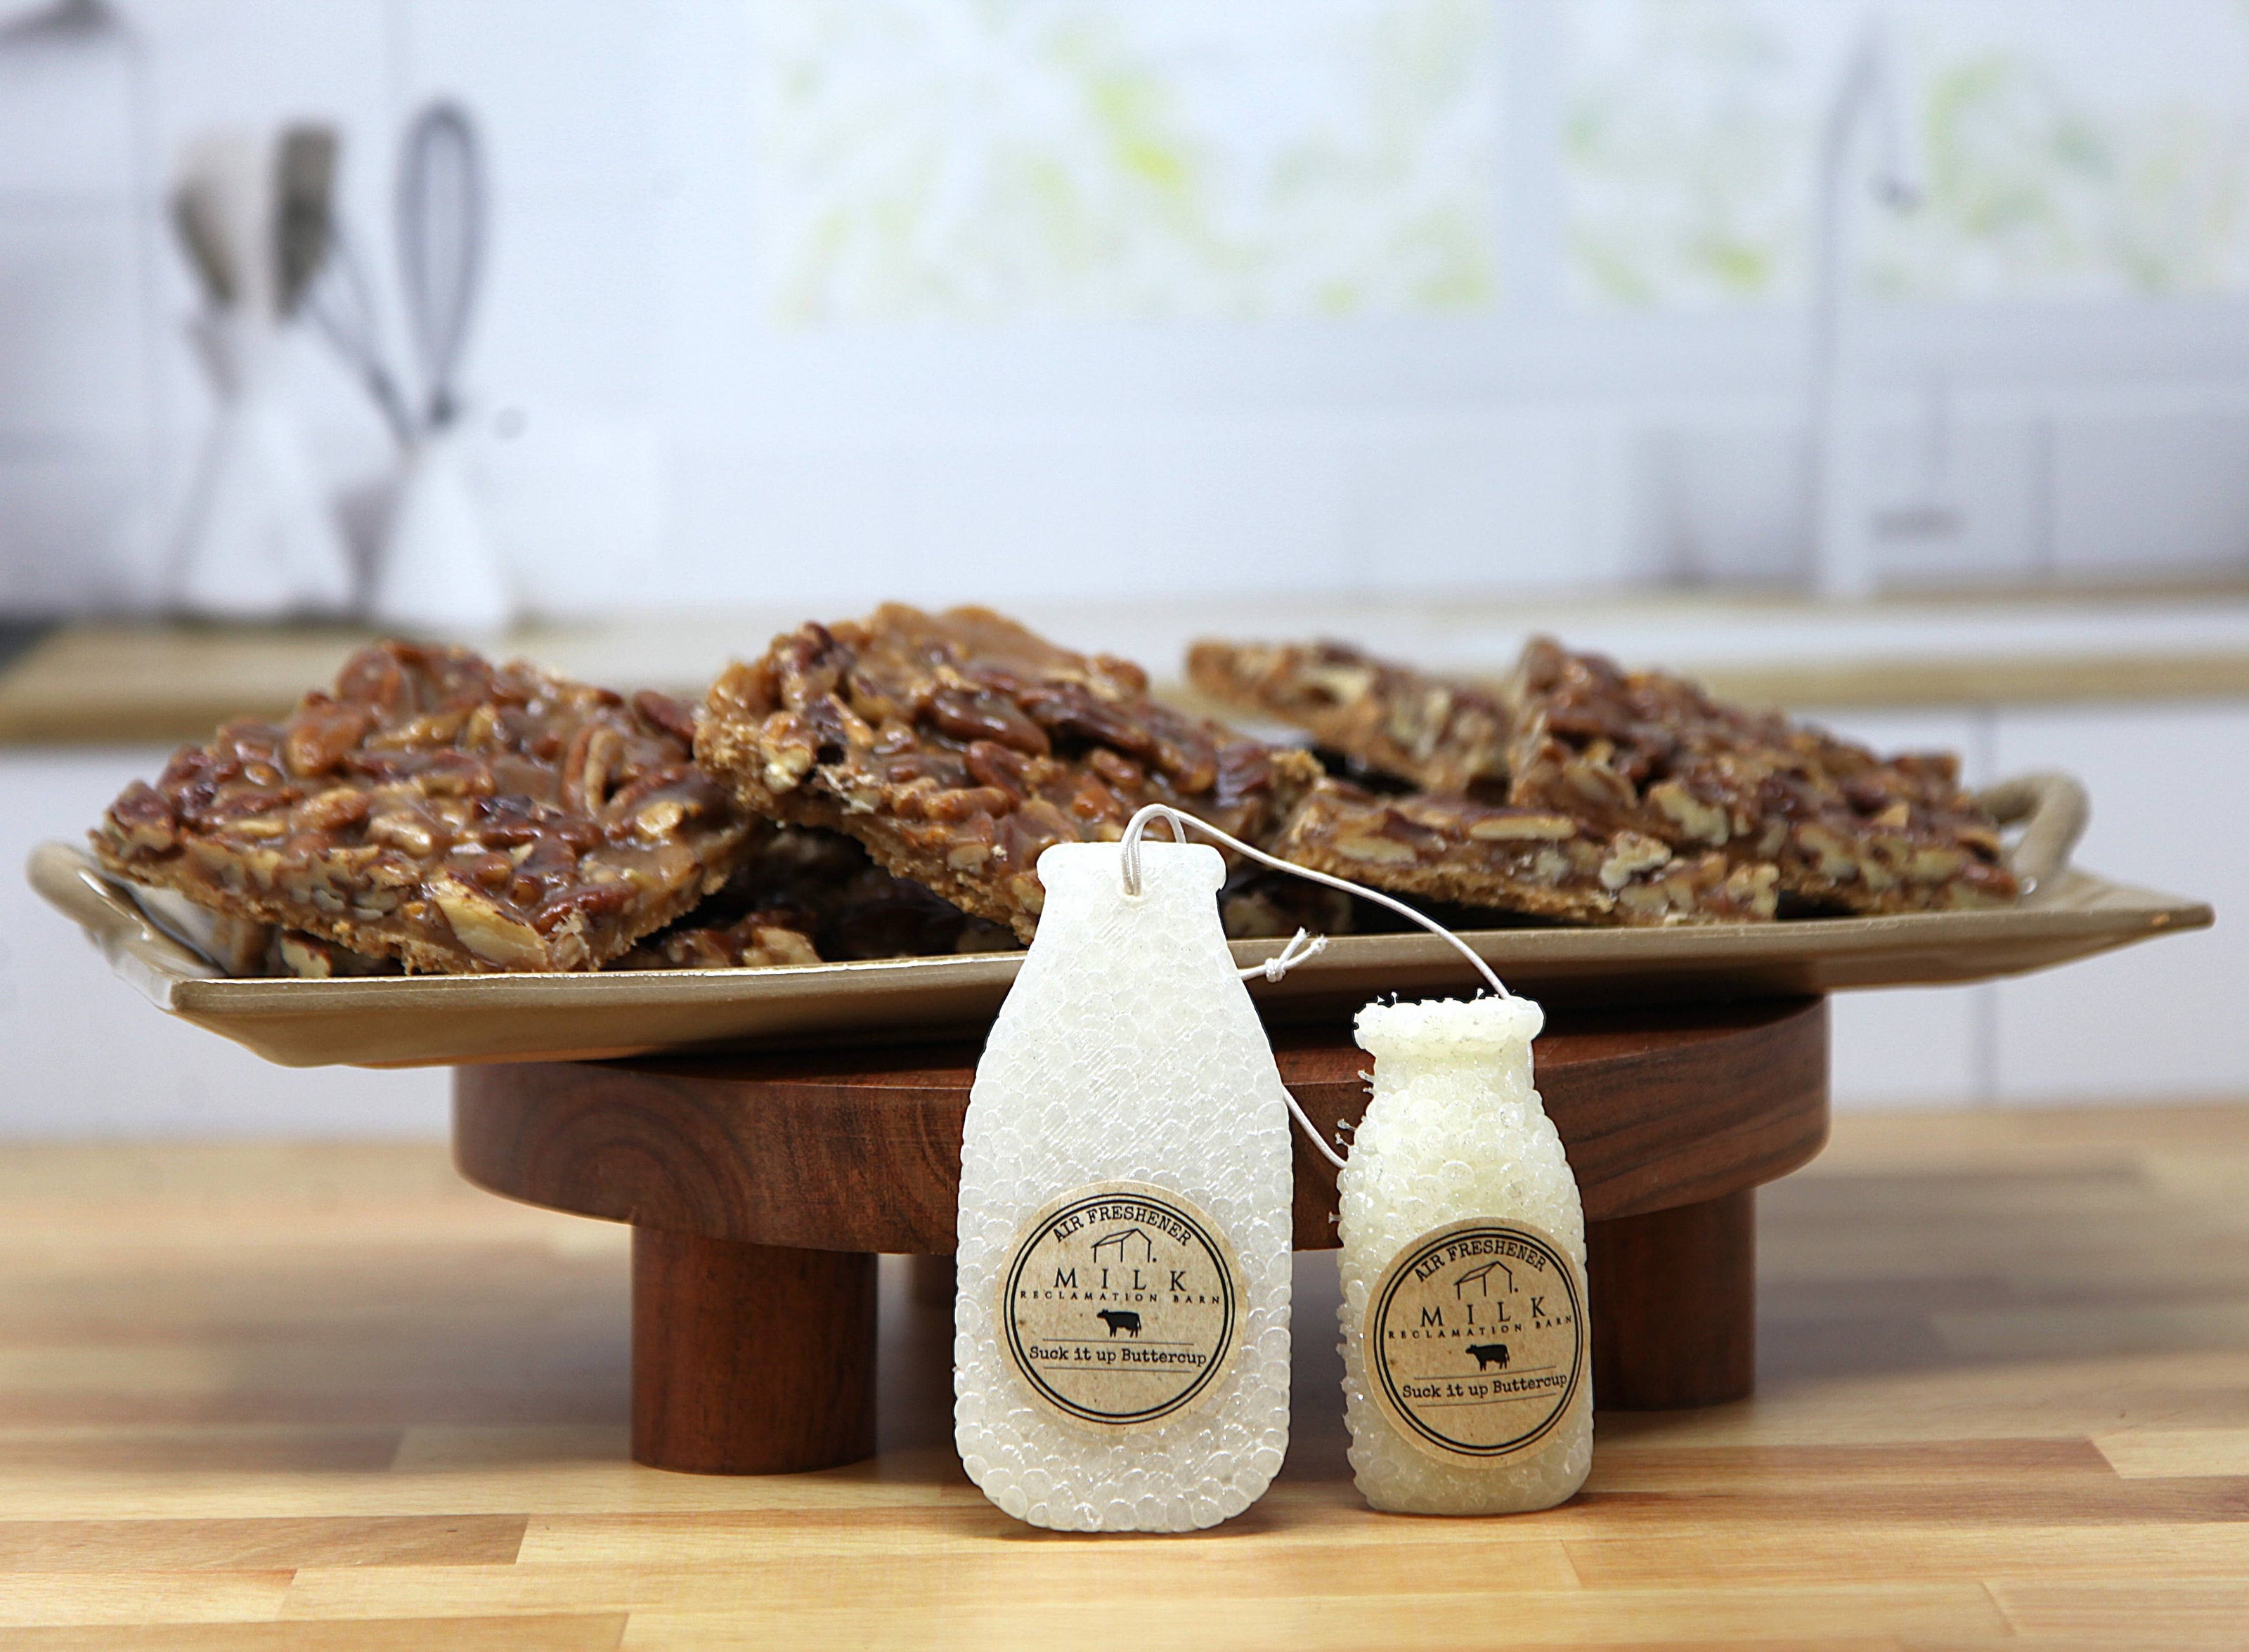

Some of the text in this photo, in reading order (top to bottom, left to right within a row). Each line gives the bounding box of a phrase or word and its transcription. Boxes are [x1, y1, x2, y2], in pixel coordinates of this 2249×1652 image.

[1054, 1205, 1192, 1246] AIR FRESHENER
[1414, 1240, 1546, 1282] AIR FRESHENER
[1054, 1267, 1187, 1292] MILK
[1020, 1290, 1220, 1305] RECLAMATION BARN
[1420, 1296, 1546, 1327] MILK
[1388, 1315, 1572, 1339] RECLAMATION BARN
[1030, 1346, 1207, 1367] Suck it up Buttercup
[1402, 1374, 1567, 1399] Suck it up Buttercup
